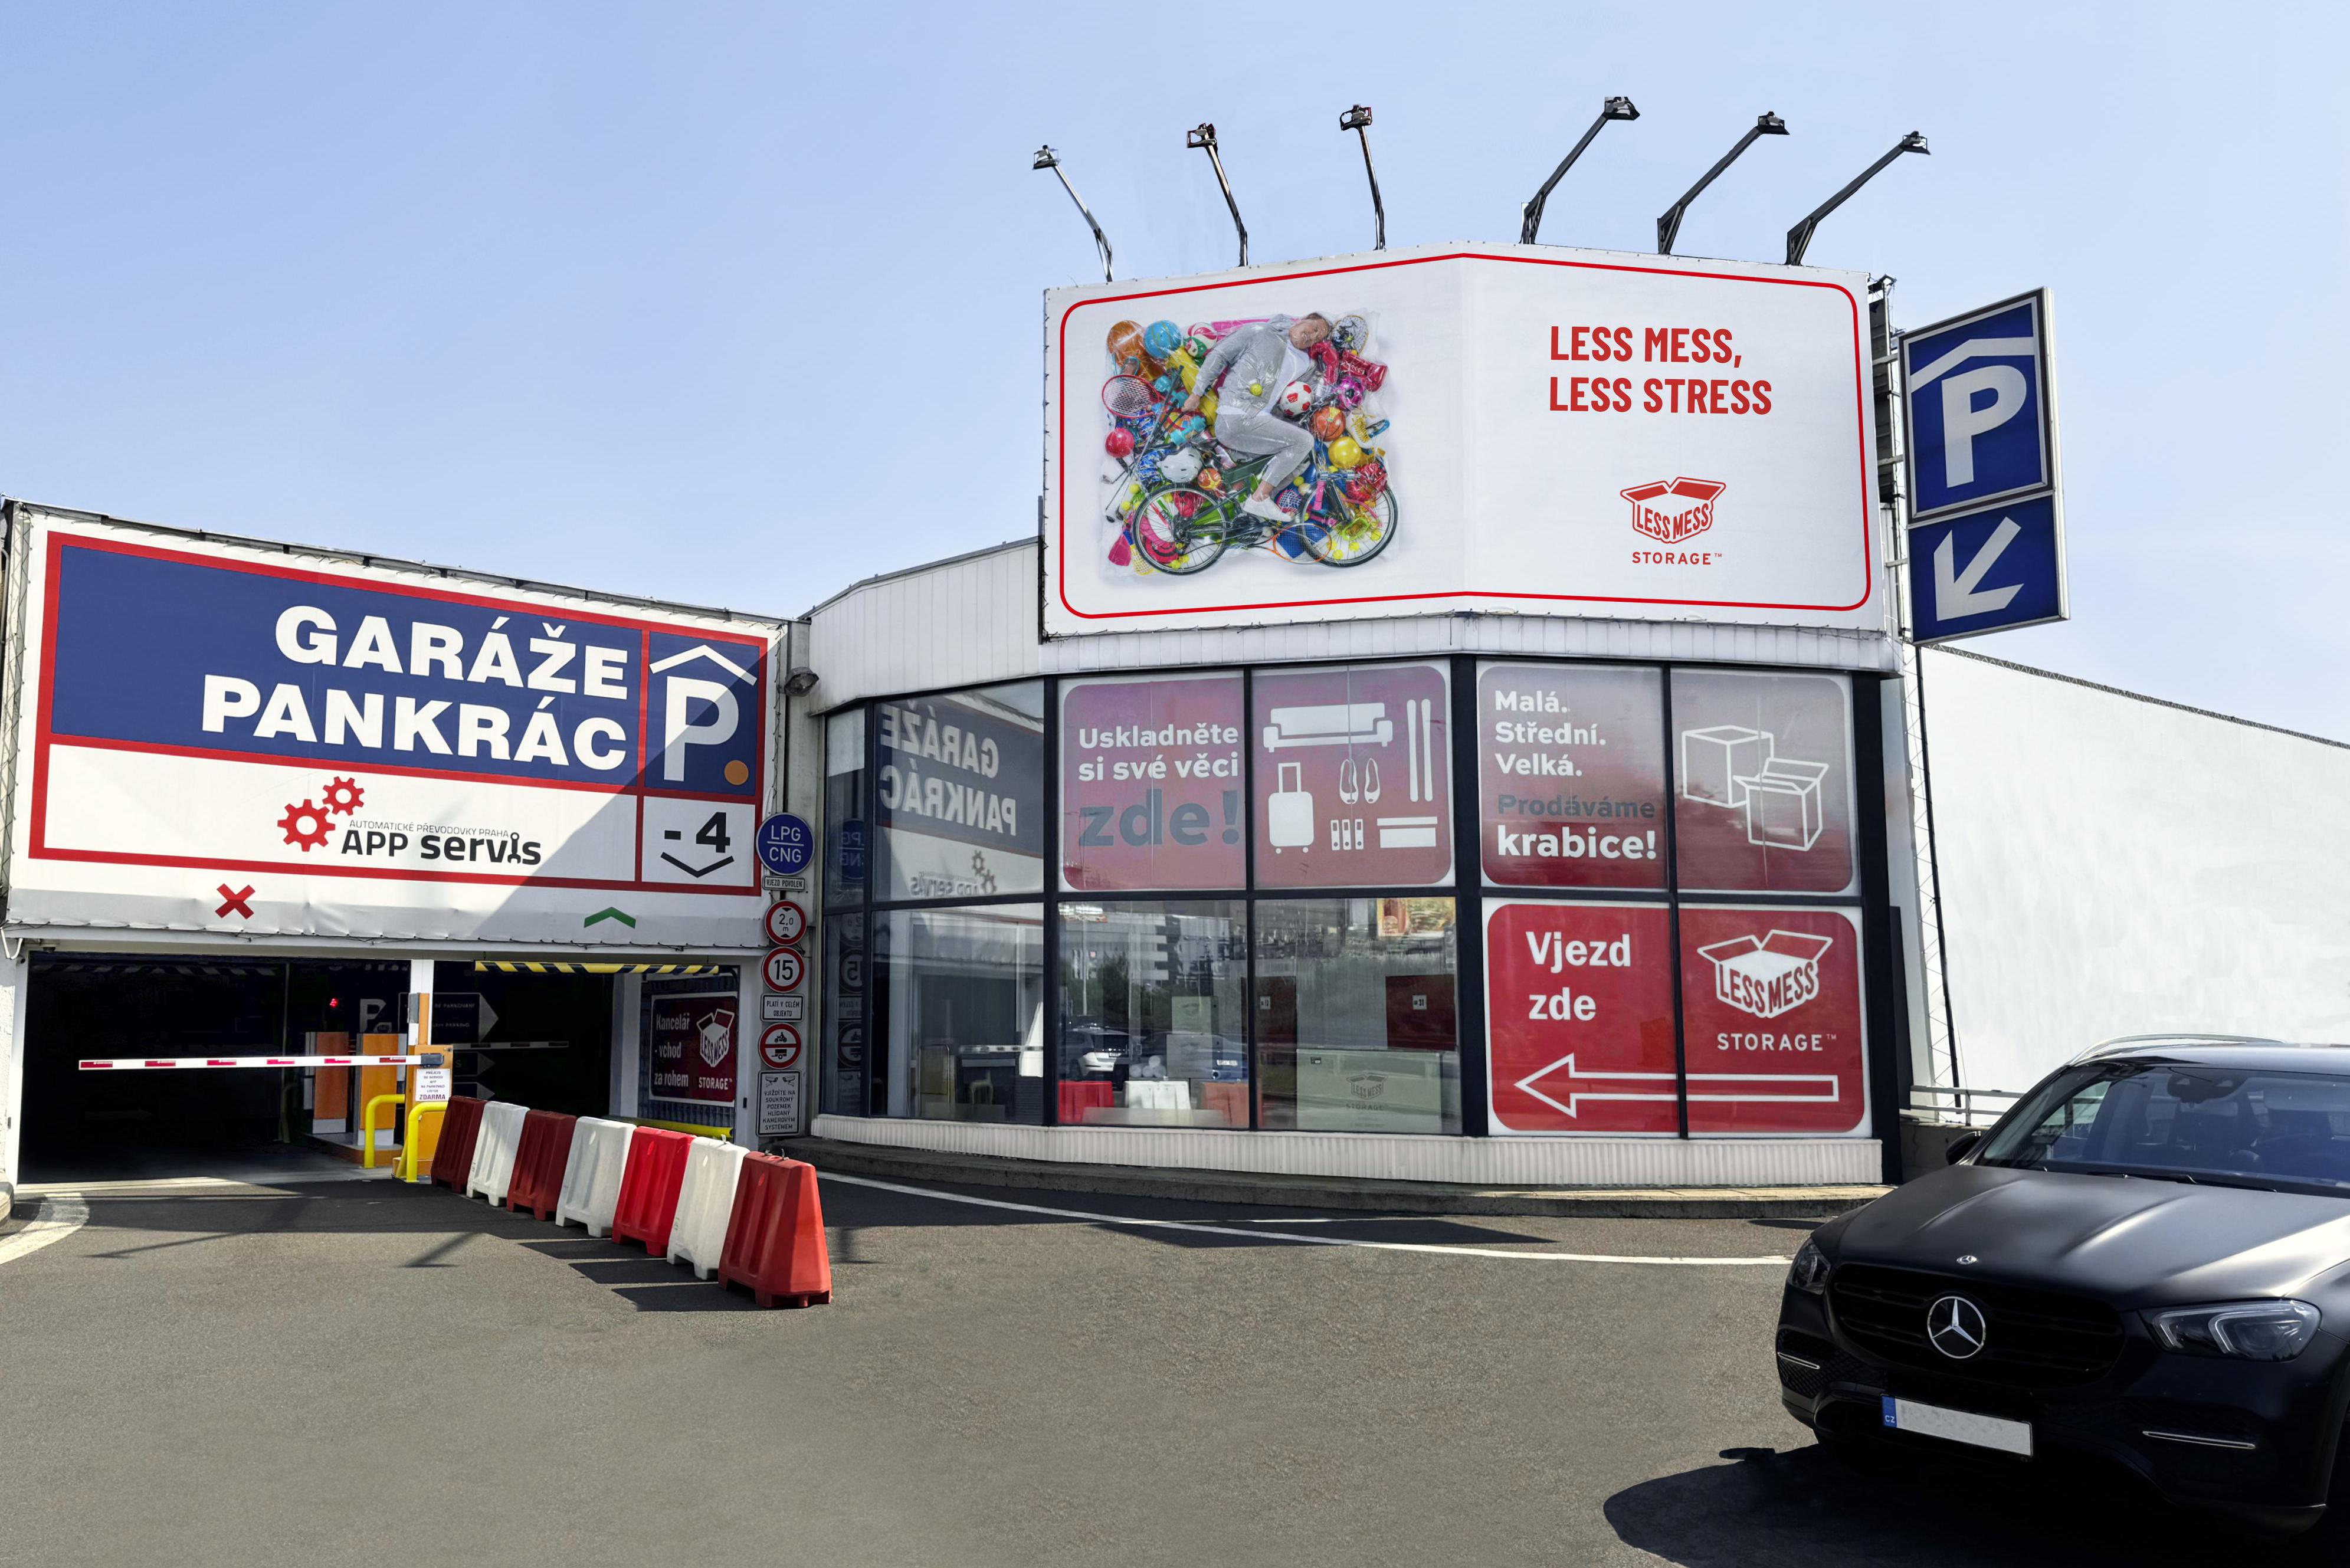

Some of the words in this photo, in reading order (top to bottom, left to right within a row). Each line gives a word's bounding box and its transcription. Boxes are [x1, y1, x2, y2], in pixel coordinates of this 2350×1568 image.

[1551, 326, 1633, 362] LESS
[1644, 327, 1742, 368] MESS,
[1549, 376, 1632, 412] LESS
[1643, 378, 1772, 415] STRESS
[1941, 365, 2027, 488] P
[1637, 504, 1670, 539] LESS
[1673, 503, 1709, 540] MESS
[1632, 551, 1711, 565] STORAGE
[275, 605, 628, 700] GARÁŽE
[1494, 690, 1568, 713] Malá.
[202, 674, 627, 770] PANKRÁC
[664, 675, 739, 782] P
[1494, 721, 1606, 745] Střední.
[1079, 723, 1239, 749] Uskladněte
[1079, 756, 1104, 782] si
[1113, 754, 1166, 780] své
[1174, 751, 1238, 778] věci
[1494, 753, 1582, 777] Velká.
[1079, 788, 1240, 847] zde!
[1498, 794, 1656, 819] Prodáváme
[349, 819, 414, 832] AUTOMATICKÉ
[417, 822, 477, 836] PŘEVODOVKY
[478, 828, 509, 838] PRAHA
[771, 825, 801, 842] LPG
[341, 829, 408, 857] APP
[420, 832, 541, 865] servis
[1497, 825, 1657, 860] krabice!
[769, 847, 802, 863] CNG
[782, 880, 803, 888] POVOLEN
[1525, 931, 1631, 974] Vjezd
[774, 959, 794, 980] 15
[1719, 963, 1766, 1014] LESS
[1768, 961, 1815, 1014] MESS
[767, 999, 779, 1008] PLATÍ
[785, 999, 800, 1008] CELÉM
[1529, 986, 1597, 1021] zde
[656, 1012, 690, 1030] Kancelář
[658, 1042, 682, 1059] vchod
[1717, 1032, 1823, 1051] STORAGE
[654, 1072, 663, 1086] za
[664, 1070, 689, 1087] rohem
[699, 1077, 729, 1090] STORAGE
[1884, 1415, 1896, 1423] CZ
